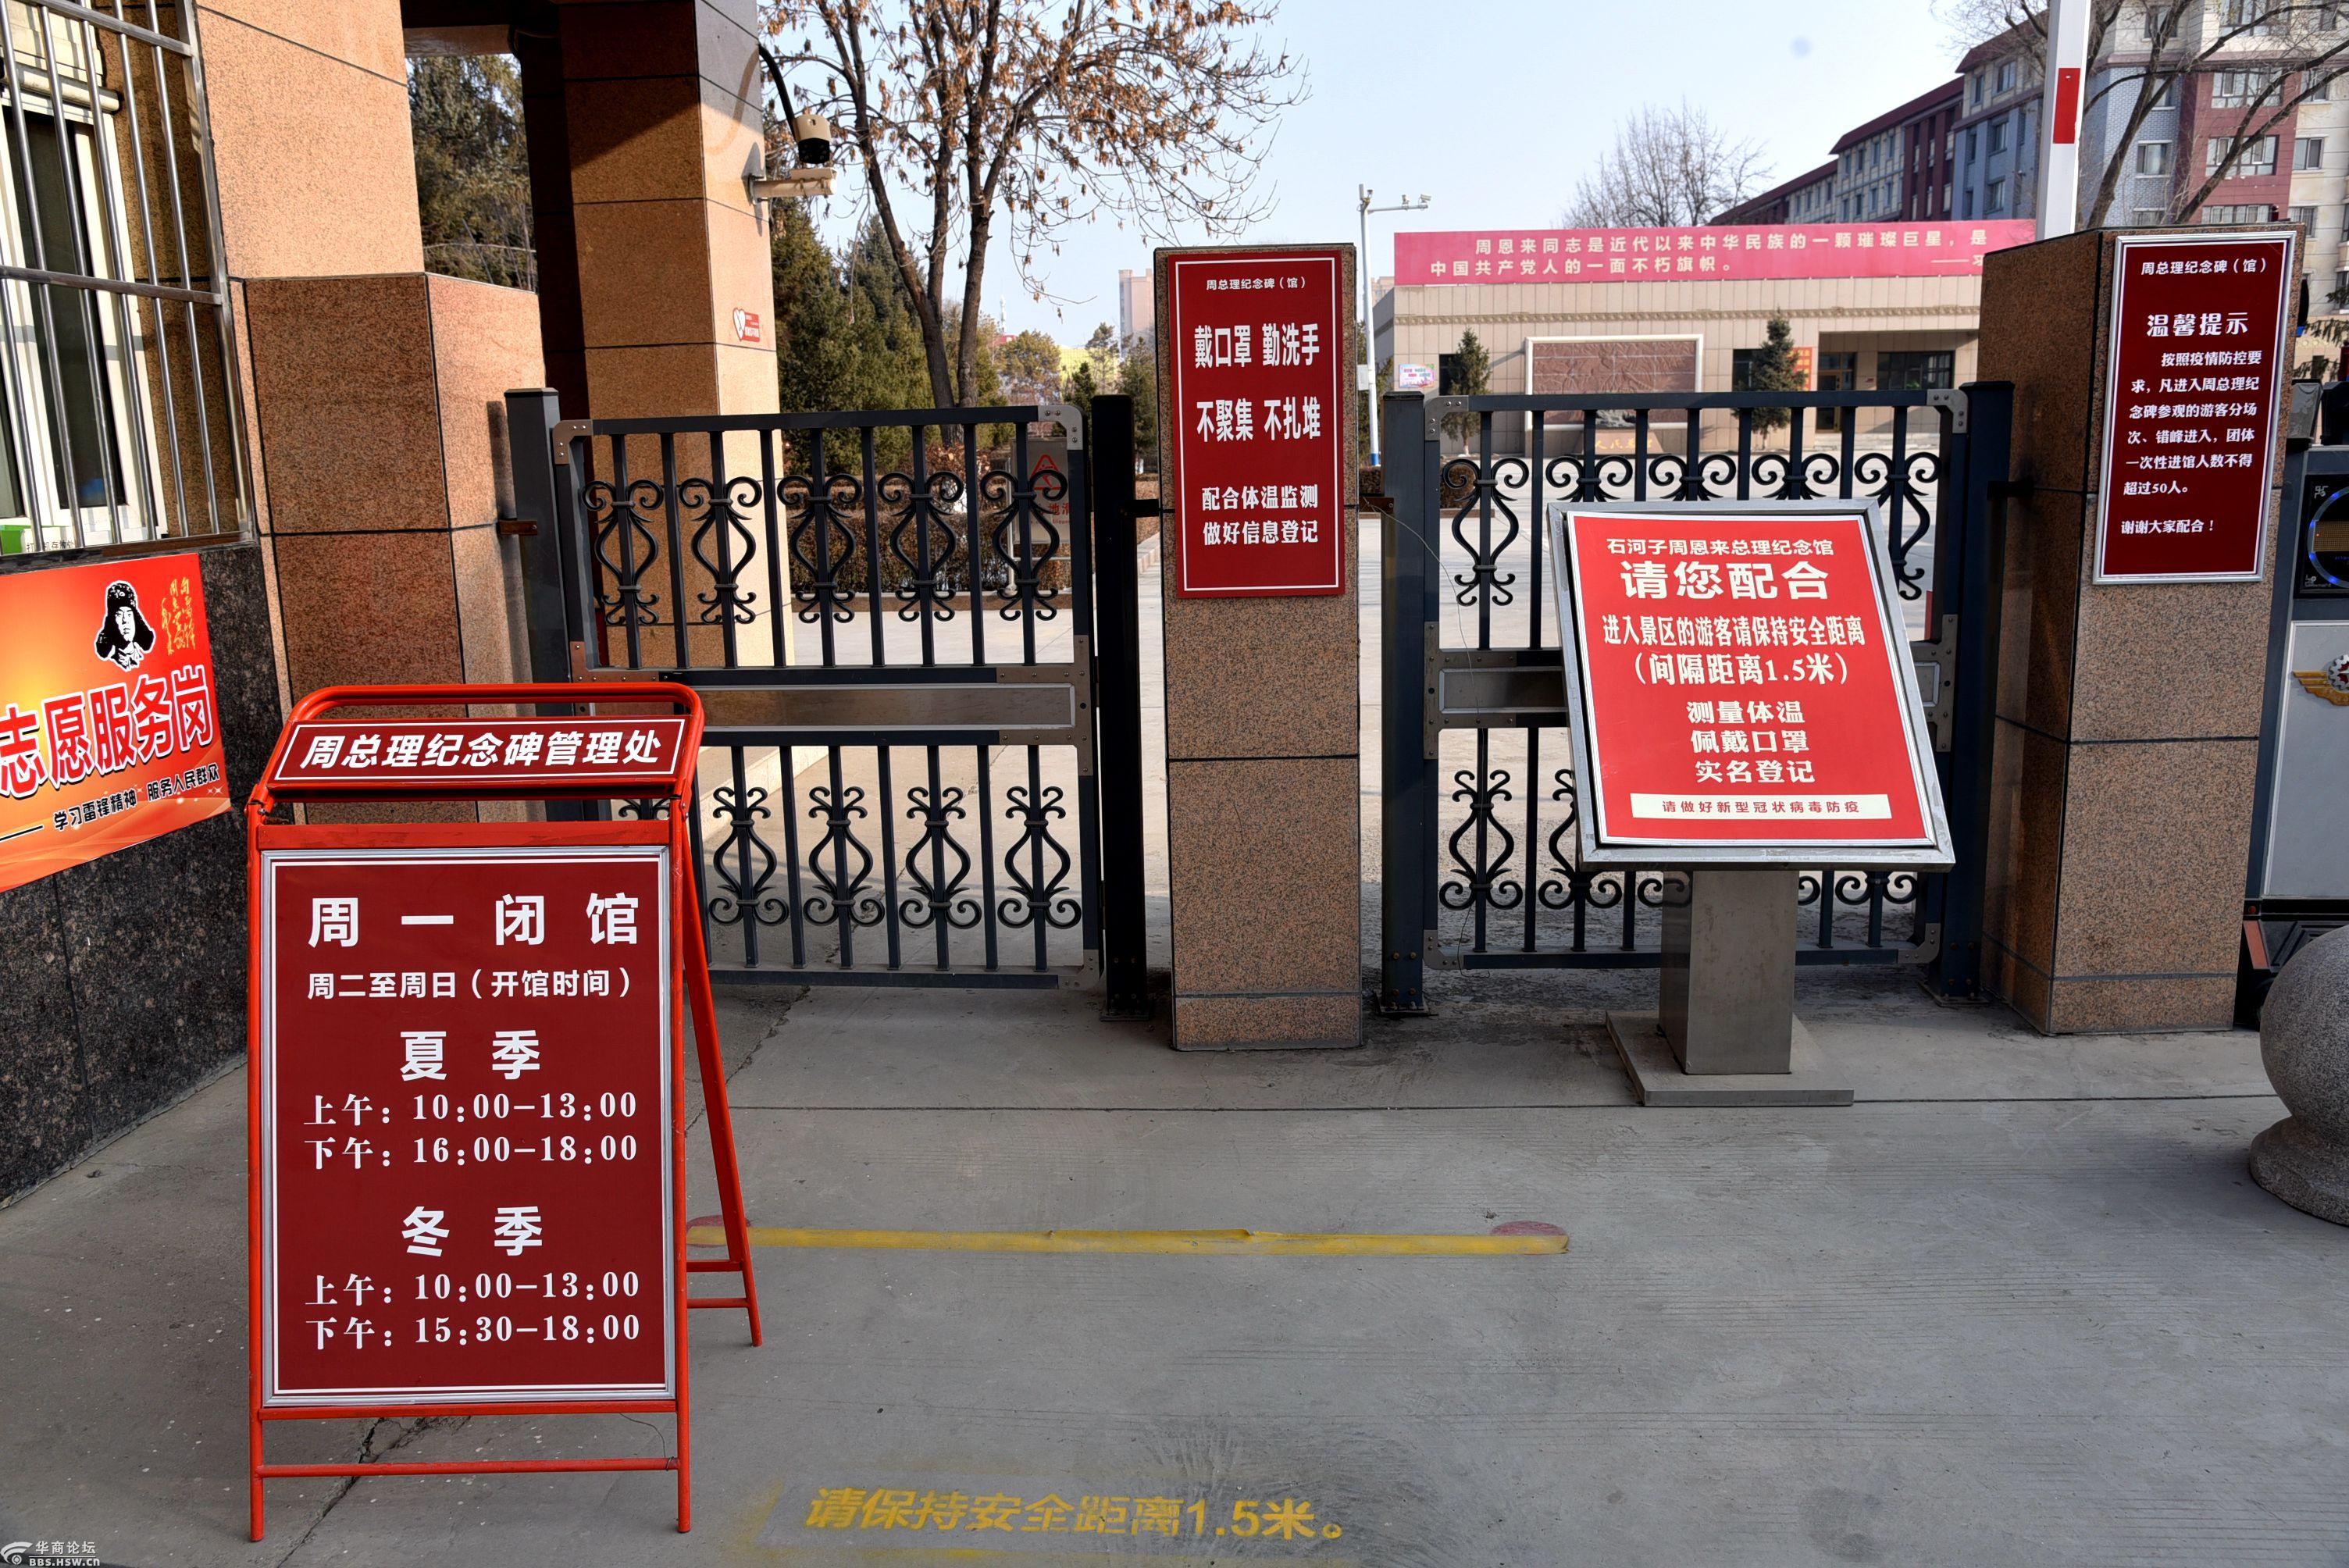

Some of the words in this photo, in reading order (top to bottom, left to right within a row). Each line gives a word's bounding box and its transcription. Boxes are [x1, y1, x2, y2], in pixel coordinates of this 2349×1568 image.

[1430, 255, 1731, 277] 中国共产党人的一面不朽旗帜。
[2140, 258, 2267, 276] 周总理纪念碑（馆）
[1206, 276, 1307, 290] 周总理纪念碑（馆）
[2146, 312, 2249, 338] 温馨提示
[1194, 325, 1253, 369] 戴口罩
[1262, 323, 1320, 367] 勤洗手
[2160, 349, 2263, 368] 按照疫情防控要
[2130, 376, 2260, 394] 求，凡进入周总理纪
[1196, 397, 1254, 443] 不聚集
[1264, 396, 1321, 440] 不扎堆
[2129, 402, 2258, 420] 念碑参观的游客分场
[2127, 428, 2255, 445] 次、错峰进入，团体
[2126, 453, 2253, 470] 一次性进馆人数不得
[1202, 483, 1318, 511] 配合体温监测
[2123, 480, 2189, 496] 超过50人。
[1203, 519, 1318, 547] 做好信息登记
[2121, 519, 2215, 536] 谢谢大家配合！
[1606, 538, 1834, 556] 石河子周恩来总理纪念馆
[1620, 560, 1829, 600] 请您配合
[1602, 614, 1866, 647] 进入景区的游客请保持安全距离
[1634, 652, 1848, 686] （间隔距离1.5米）
[1686, 700, 1805, 724] 测量体温
[0, 665, 214, 799] 志愿服务岗
[1690, 729, 1809, 754] 佩戴口罩
[300, 729, 662, 770] 周总理纪念碑管理处
[1695, 760, 1816, 783] 实名登记
[54, 789, 138, 831] 学习雷锋精神
[147, 762, 219, 802] 服务人民群众
[1661, 799, 1859, 814] 请做好新型冠状病毒防疫
[307, 967, 631, 1000] 周二至周日（开馆时间）
[804, 1486, 1343, 1541] 请保持安全距离1.5米。
